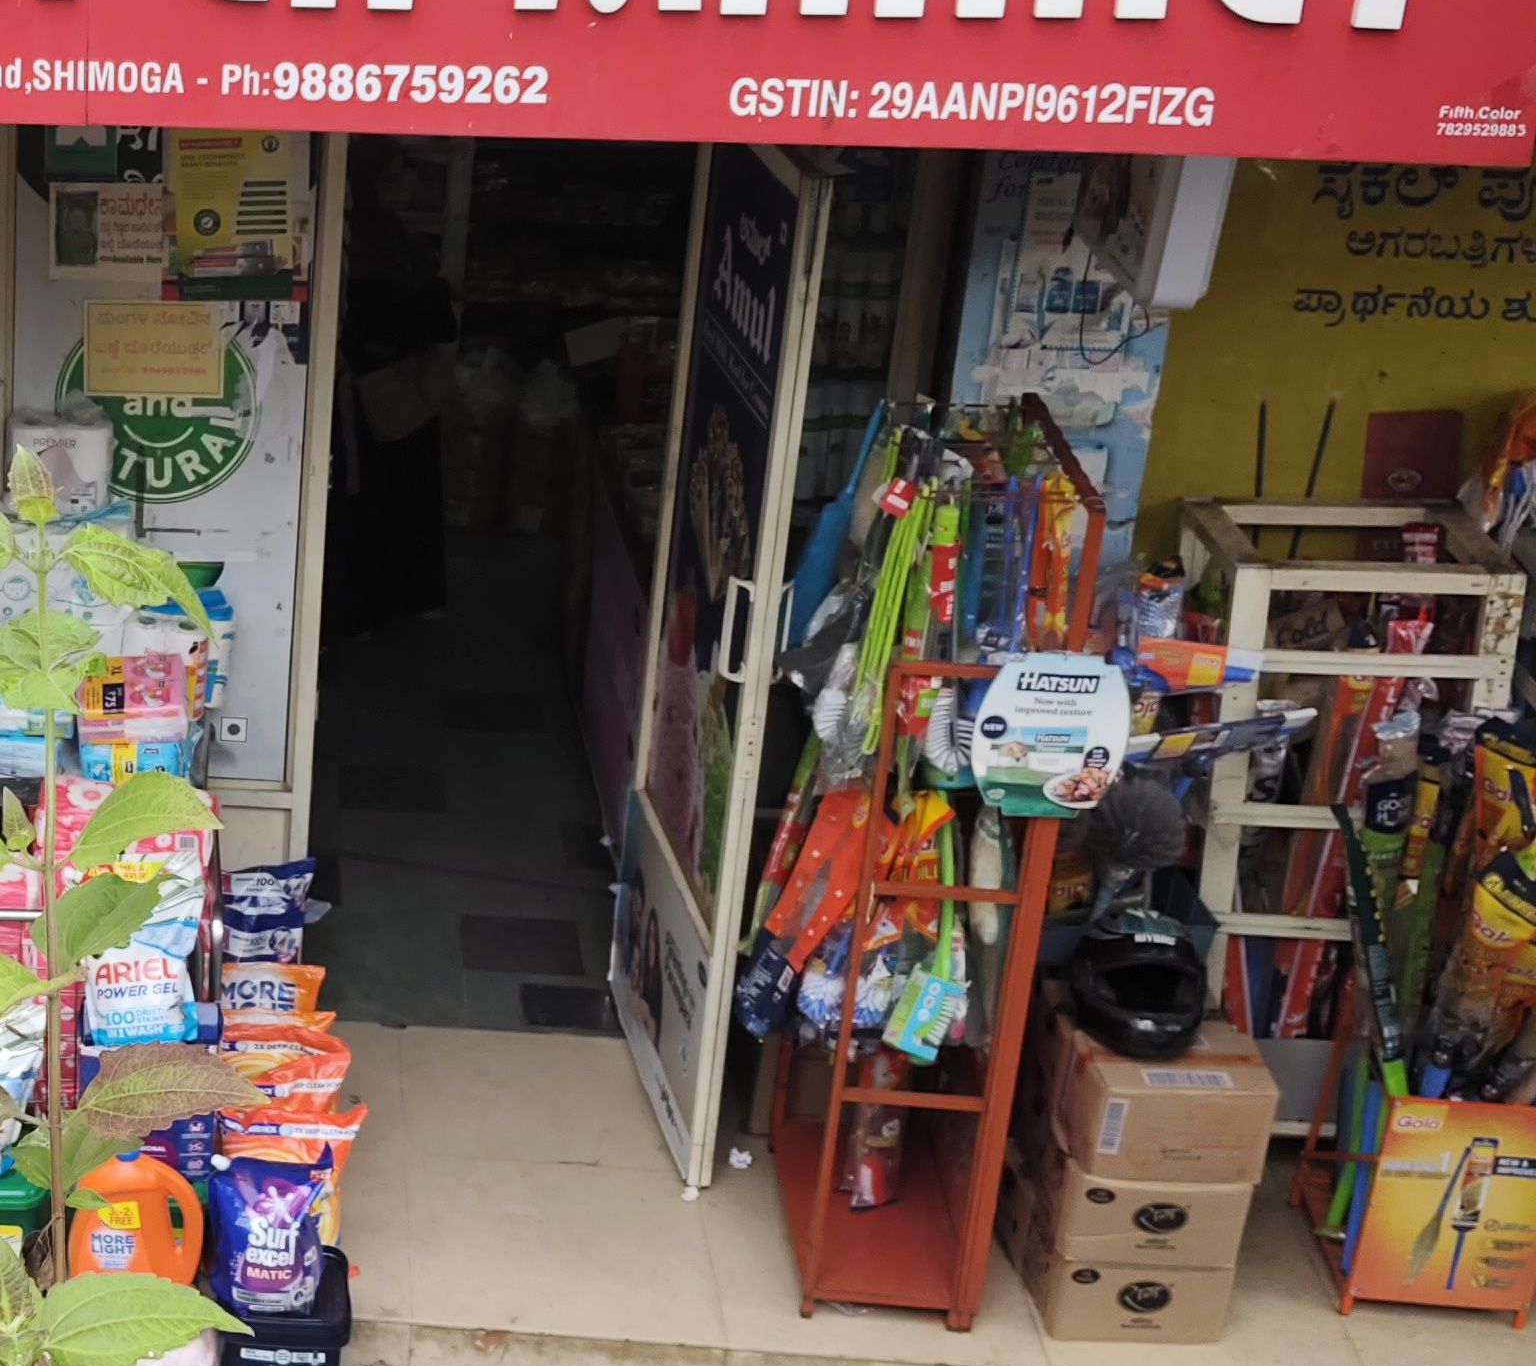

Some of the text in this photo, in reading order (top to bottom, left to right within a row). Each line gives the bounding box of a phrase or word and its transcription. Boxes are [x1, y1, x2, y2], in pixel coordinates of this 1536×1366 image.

[728, 77, 859, 119] GSTIN:
[1478, 106, 1522, 120] Color
[712, 223, 776, 365] Amul
[123, 396, 194, 418] and
[33, 437, 77, 449] PREMIER
[115, 414, 242, 488] TURAL
[1019, 671, 1098, 693] HATSUN
[1034, 697, 1077, 706] Now with
[1015, 707, 1093, 716] improved texture
[982, 722, 1005, 732] NEW
[95, 957, 178, 986] ARIEL
[97, 982, 179, 1000] POWER GEL
[221, 979, 296, 1002] MORE
[105, 1011, 136, 1025] 100
[127, 1025, 164, 1037] WASH
[1397, 1115, 1440, 1130] Gala
[110, 1215, 134, 1226] FREE
[91, 1233, 135, 1245] MORE
[248, 1216, 301, 1251] Surf
[92, 1244, 135, 1255] LIGHT
[246, 1245, 296, 1267] excel
[246, 1266, 293, 1281] MATIC
